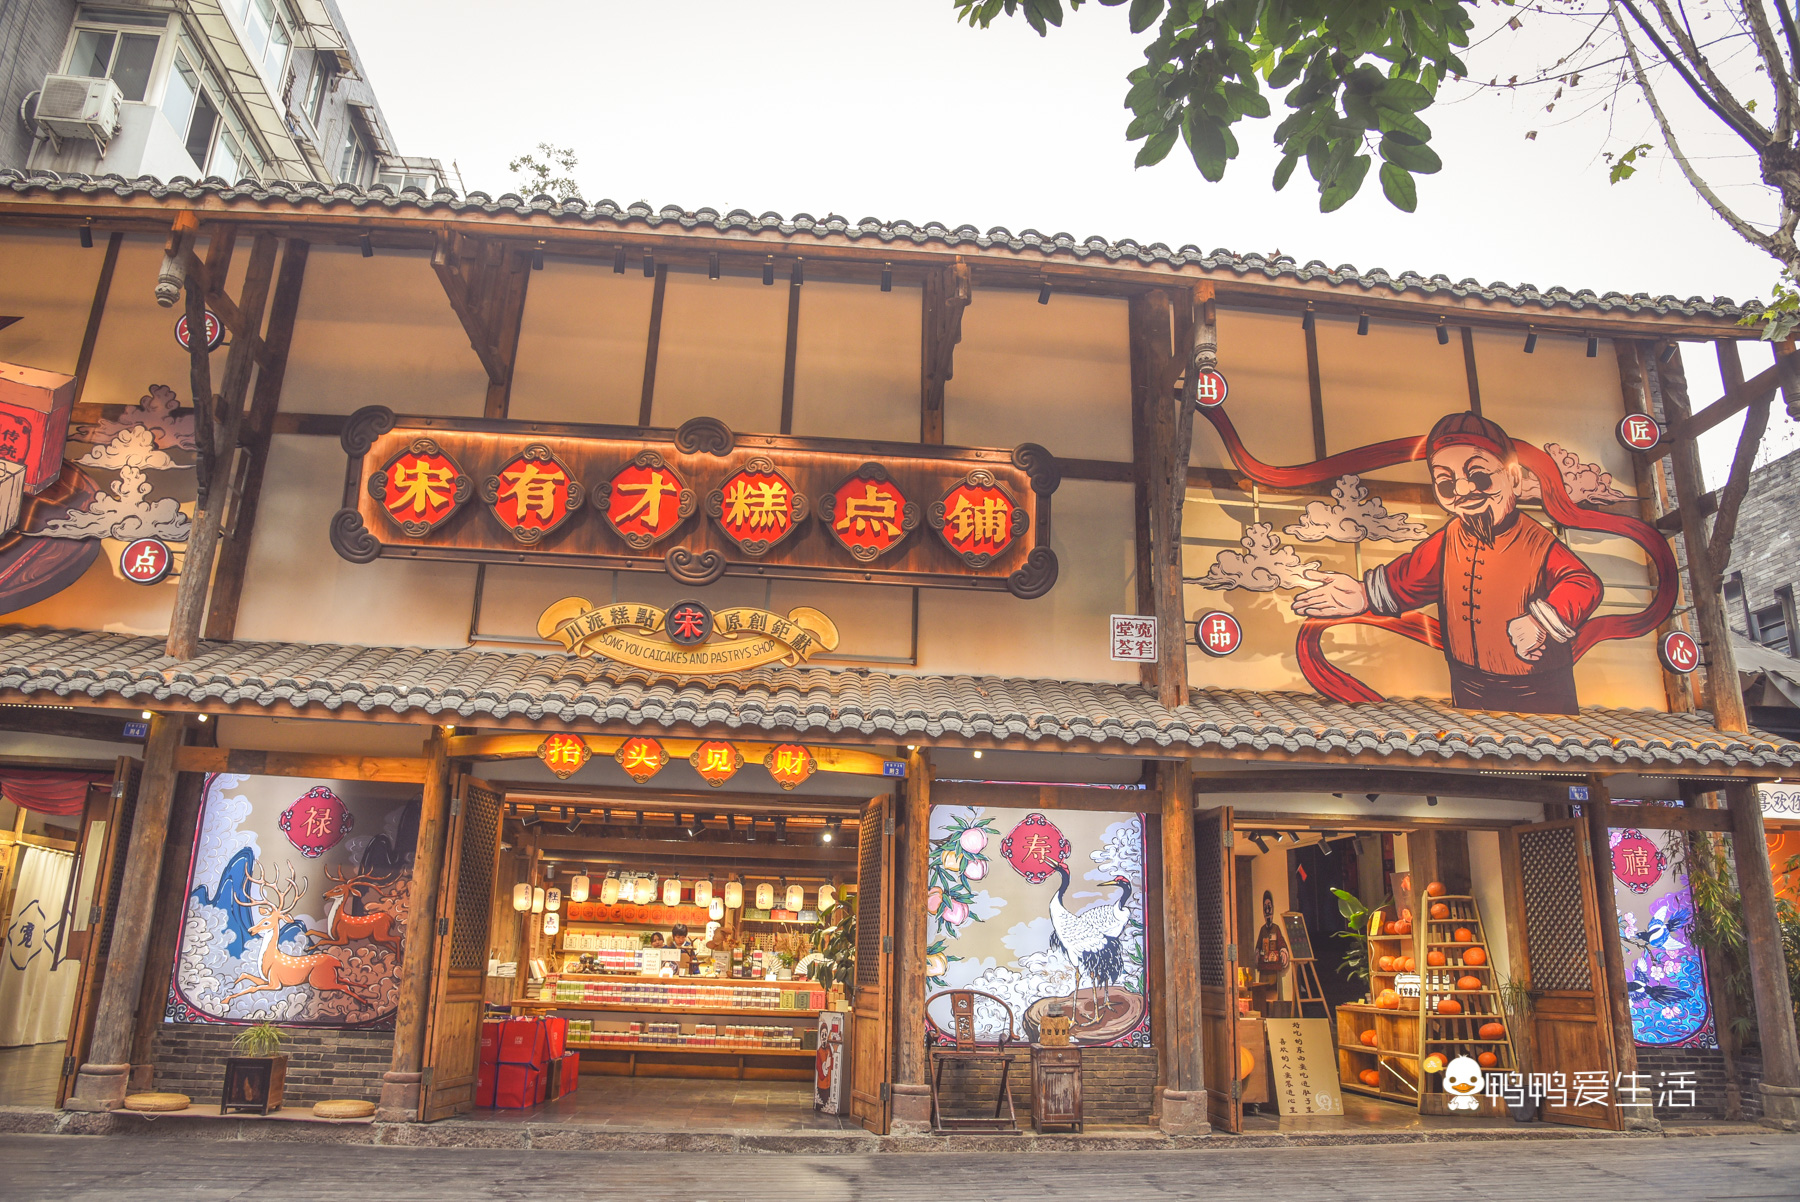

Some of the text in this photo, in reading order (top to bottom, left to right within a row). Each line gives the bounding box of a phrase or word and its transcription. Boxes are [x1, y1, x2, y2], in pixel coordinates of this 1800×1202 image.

[1197, 374, 1218, 401] 出
[1629, 419, 1652, 443] 匠
[388, 460, 1009, 543] 宋有才糕点铺
[129, 545, 159, 575] 点
[564, 604, 657, 645] 川派糕點
[673, 606, 704, 639] 宋
[723, 609, 816, 658] 原創鉅獻
[1209, 618, 1231, 648] 品
[600, 632, 623, 650] SONG
[625, 641, 642, 657] YOU
[642, 647, 688, 665] CAICAKES
[689, 652, 709, 665] AND
[752, 639, 776, 657] SHOP
[1671, 638, 1693, 665] 心
[548, 737, 807, 778] 抬头见财
[299, 806, 333, 838] 禄
[1021, 833, 1052, 864] 寿
[1622, 846, 1651, 877] 禧
